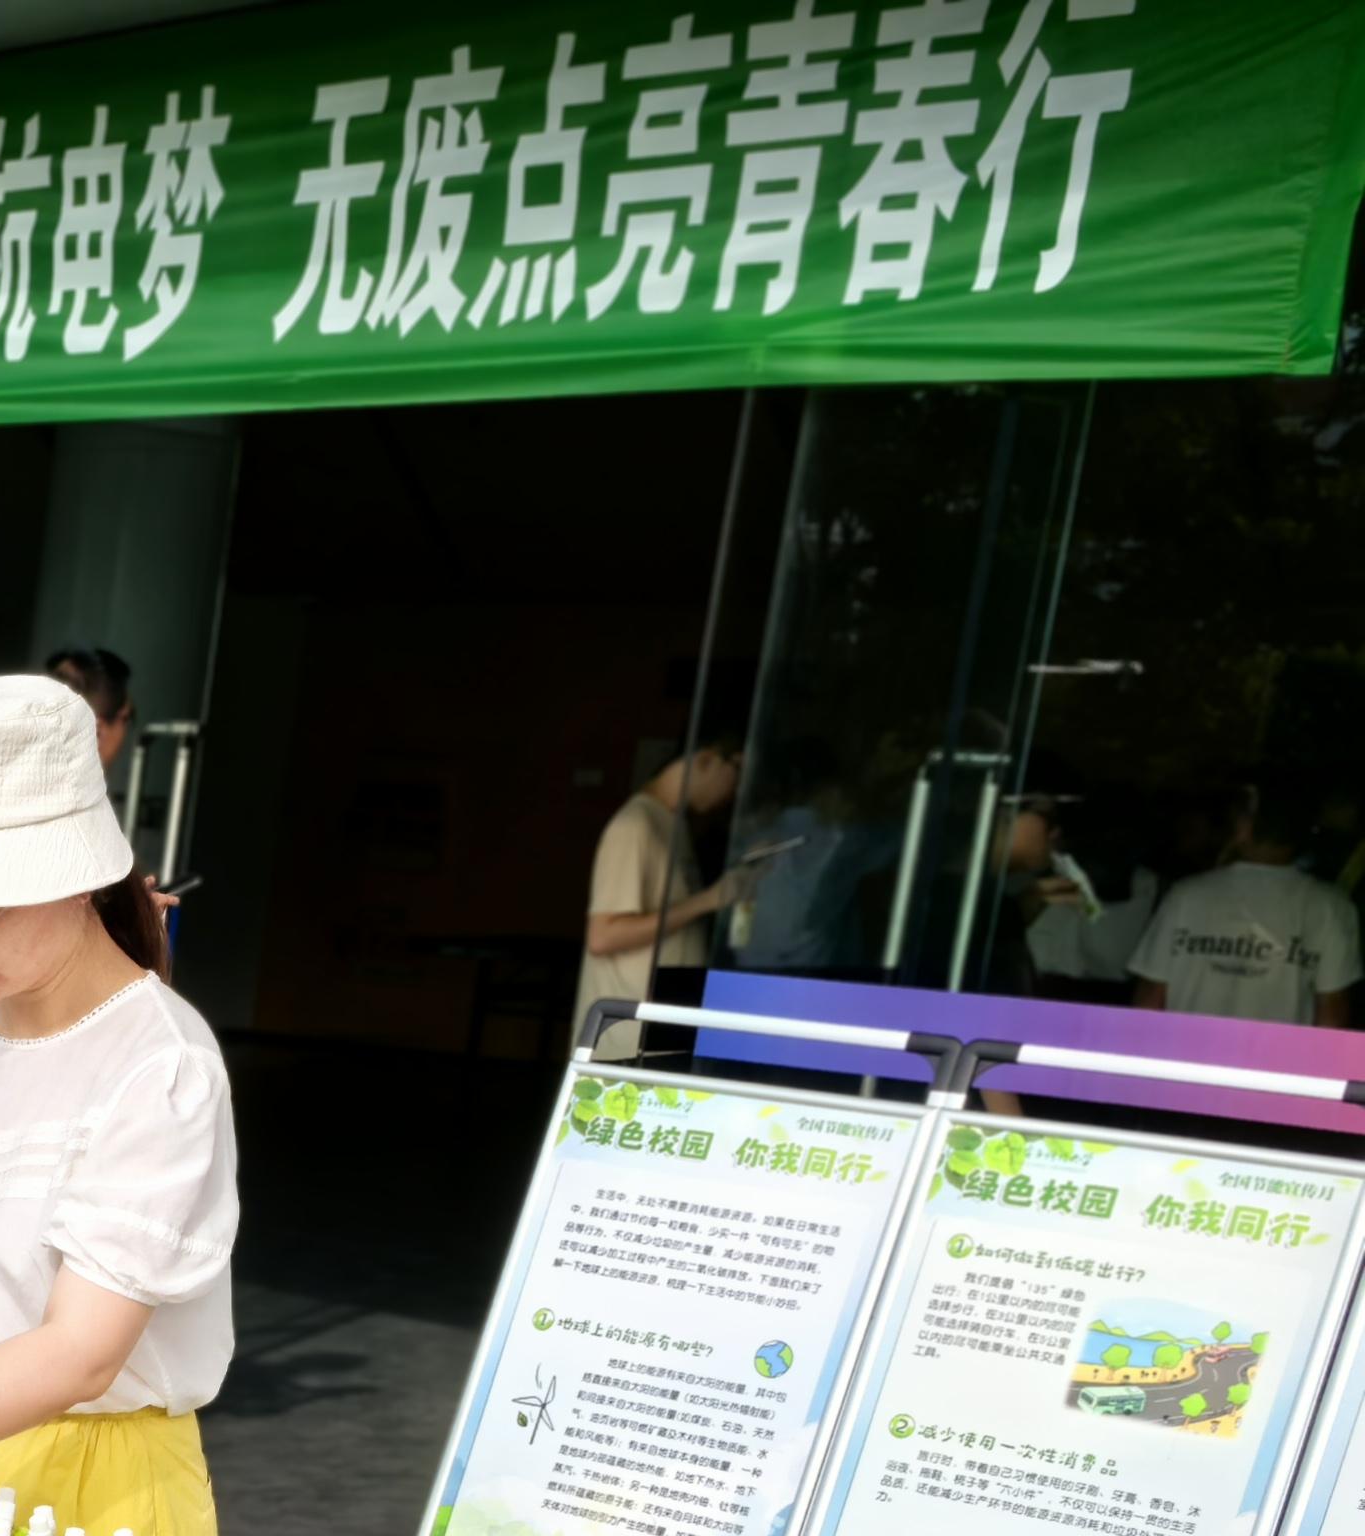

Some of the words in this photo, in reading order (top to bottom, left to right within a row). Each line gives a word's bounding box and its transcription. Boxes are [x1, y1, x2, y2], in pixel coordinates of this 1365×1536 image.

[273, 0, 1135, 343] 无废点亮青春行
[584, 1115, 715, 1162] 绿色校园
[734, 1137, 874, 1185] 你我同行
[796, 1116, 895, 1143] 全国节能宣传月
[961, 1168, 1119, 1220] 绿色校园
[1144, 1193, 1312, 1249] 你我同行
[1217, 1171, 1336, 1202] 全国节能宣传月
[918, 1422, 1118, 1477] 减少使用一次性消费品
